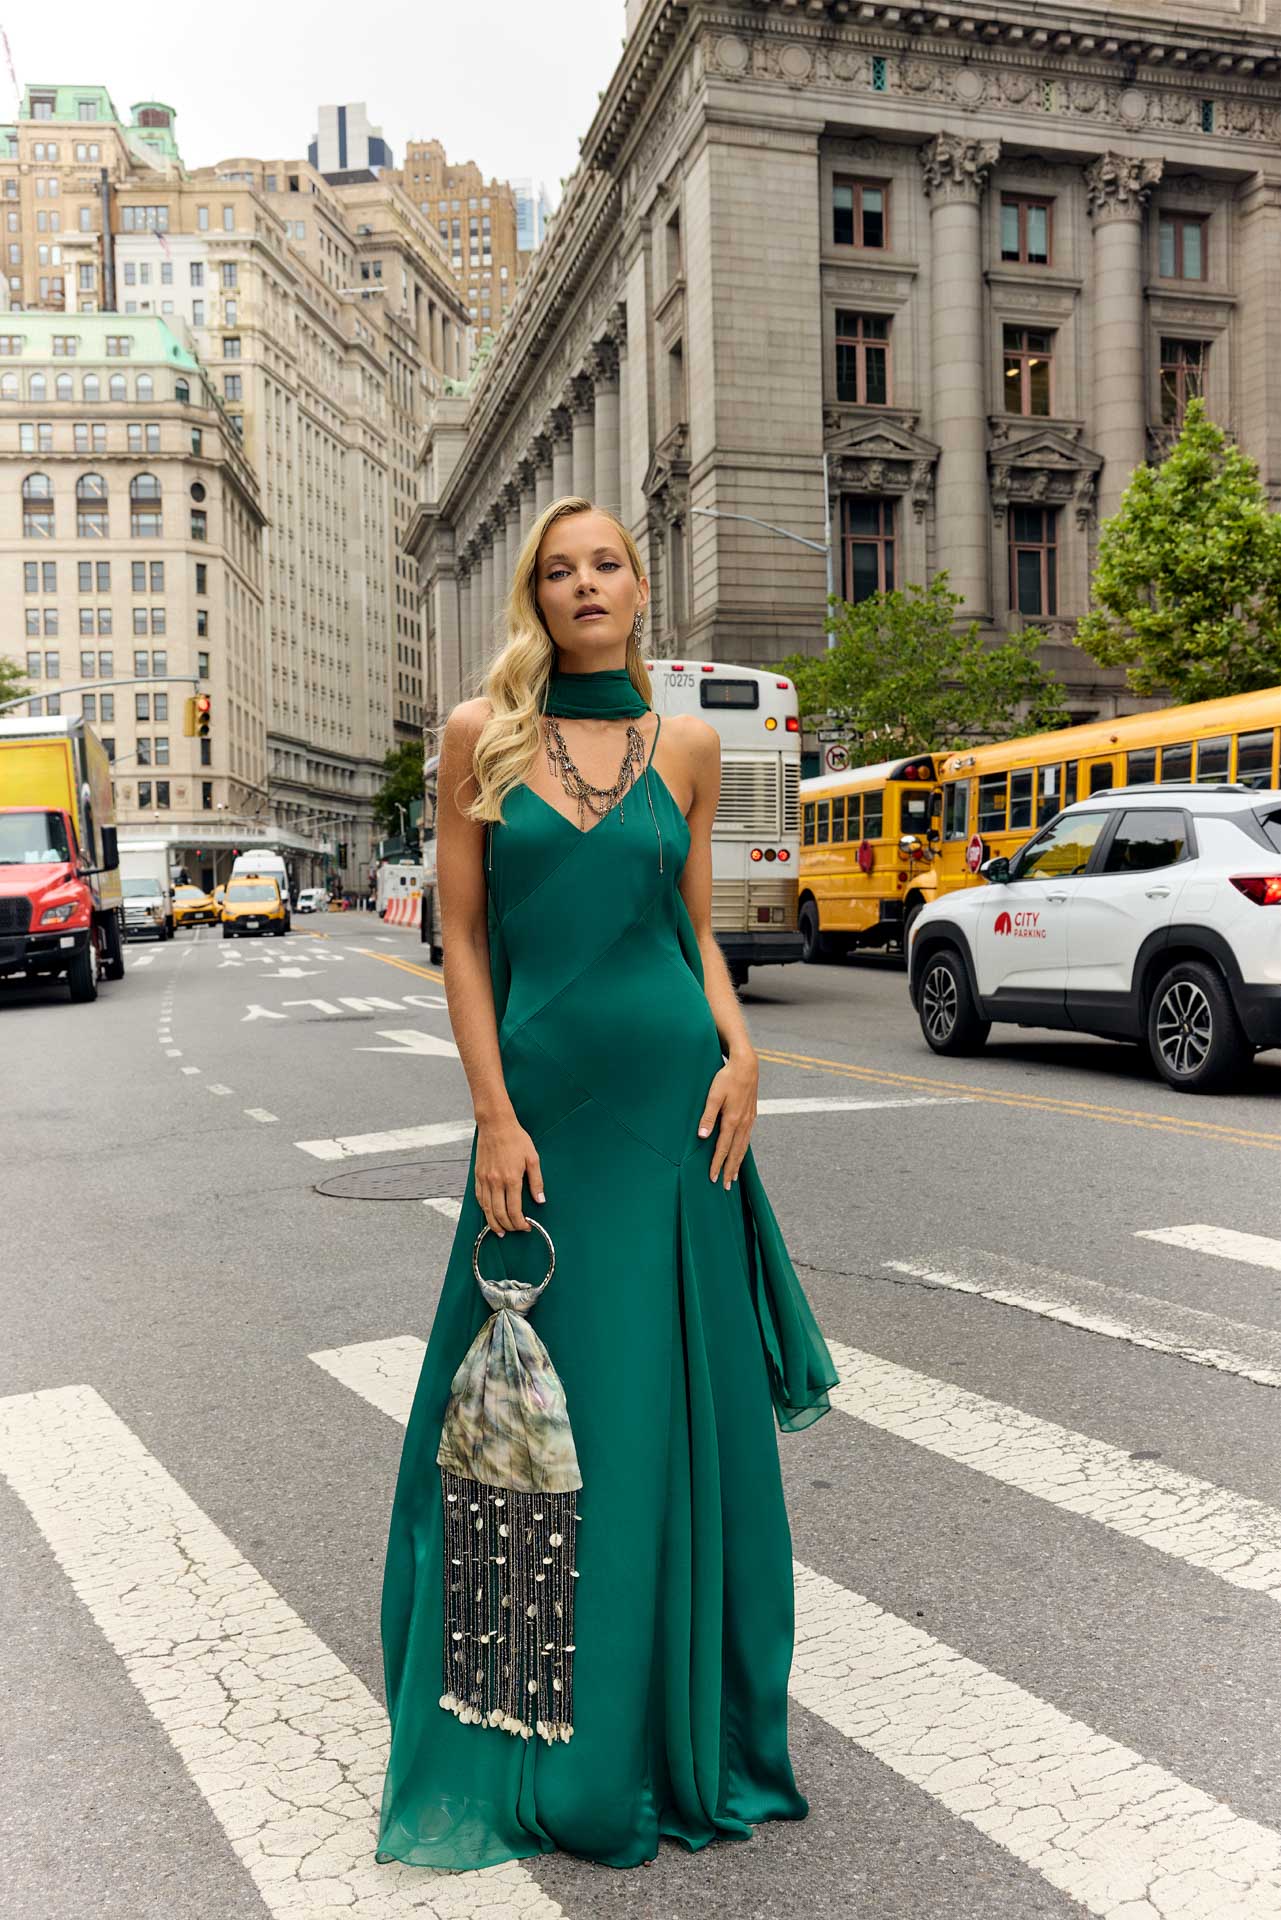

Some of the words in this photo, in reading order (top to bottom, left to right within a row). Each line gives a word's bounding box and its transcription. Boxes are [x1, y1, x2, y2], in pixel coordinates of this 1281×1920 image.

[664, 673, 695, 688] 70275
[1014, 911, 1040, 927] CITY
[1014, 928, 1047, 939] PARKING
[217, 953, 345, 968] ONLY
[240, 994, 449, 1022] ONLY
